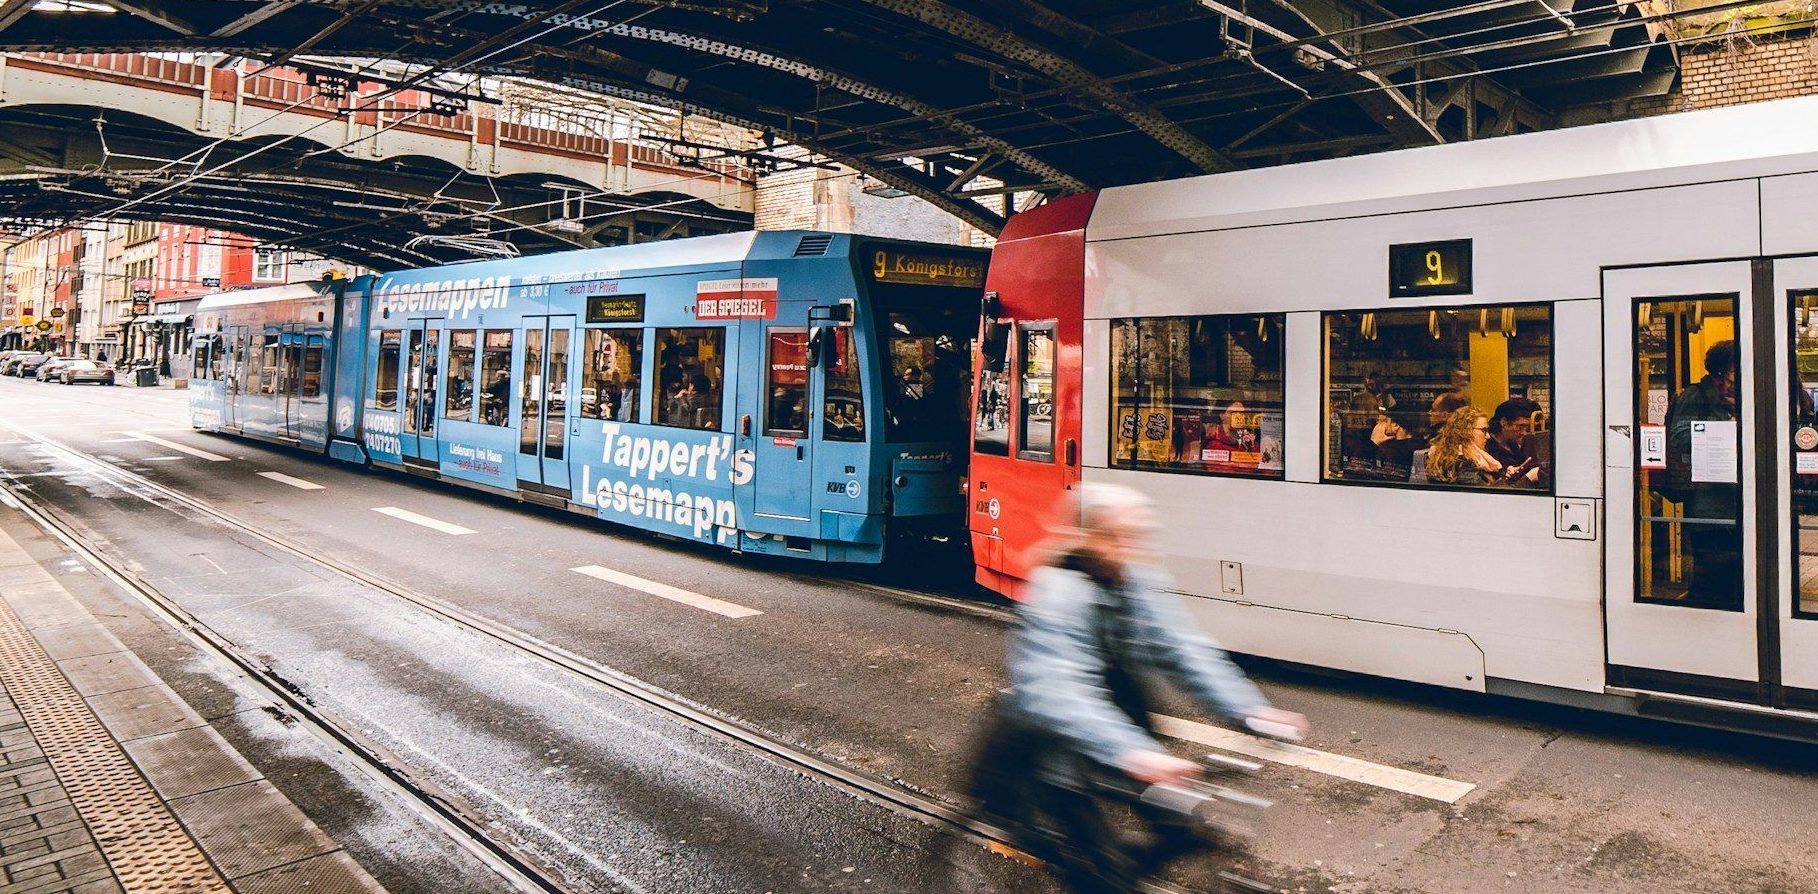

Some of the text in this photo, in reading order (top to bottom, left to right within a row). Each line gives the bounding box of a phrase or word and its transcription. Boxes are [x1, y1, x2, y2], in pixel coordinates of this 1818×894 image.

[874, 251, 886, 278] 9
[1426, 250, 1443, 285] 9
[377, 275, 511, 319] Lesemappen
[600, 281, 619, 293] Privat
[698, 298, 766, 317] DER SPIEGEL
[365, 433, 401, 456] 7407270
[450, 443, 475, 461] Lieferung
[487, 449, 503, 464] Haus
[602, 423, 755, 485] Tappert's
[827, 481, 847, 495] KVB
[976, 500, 990, 513] KVB
